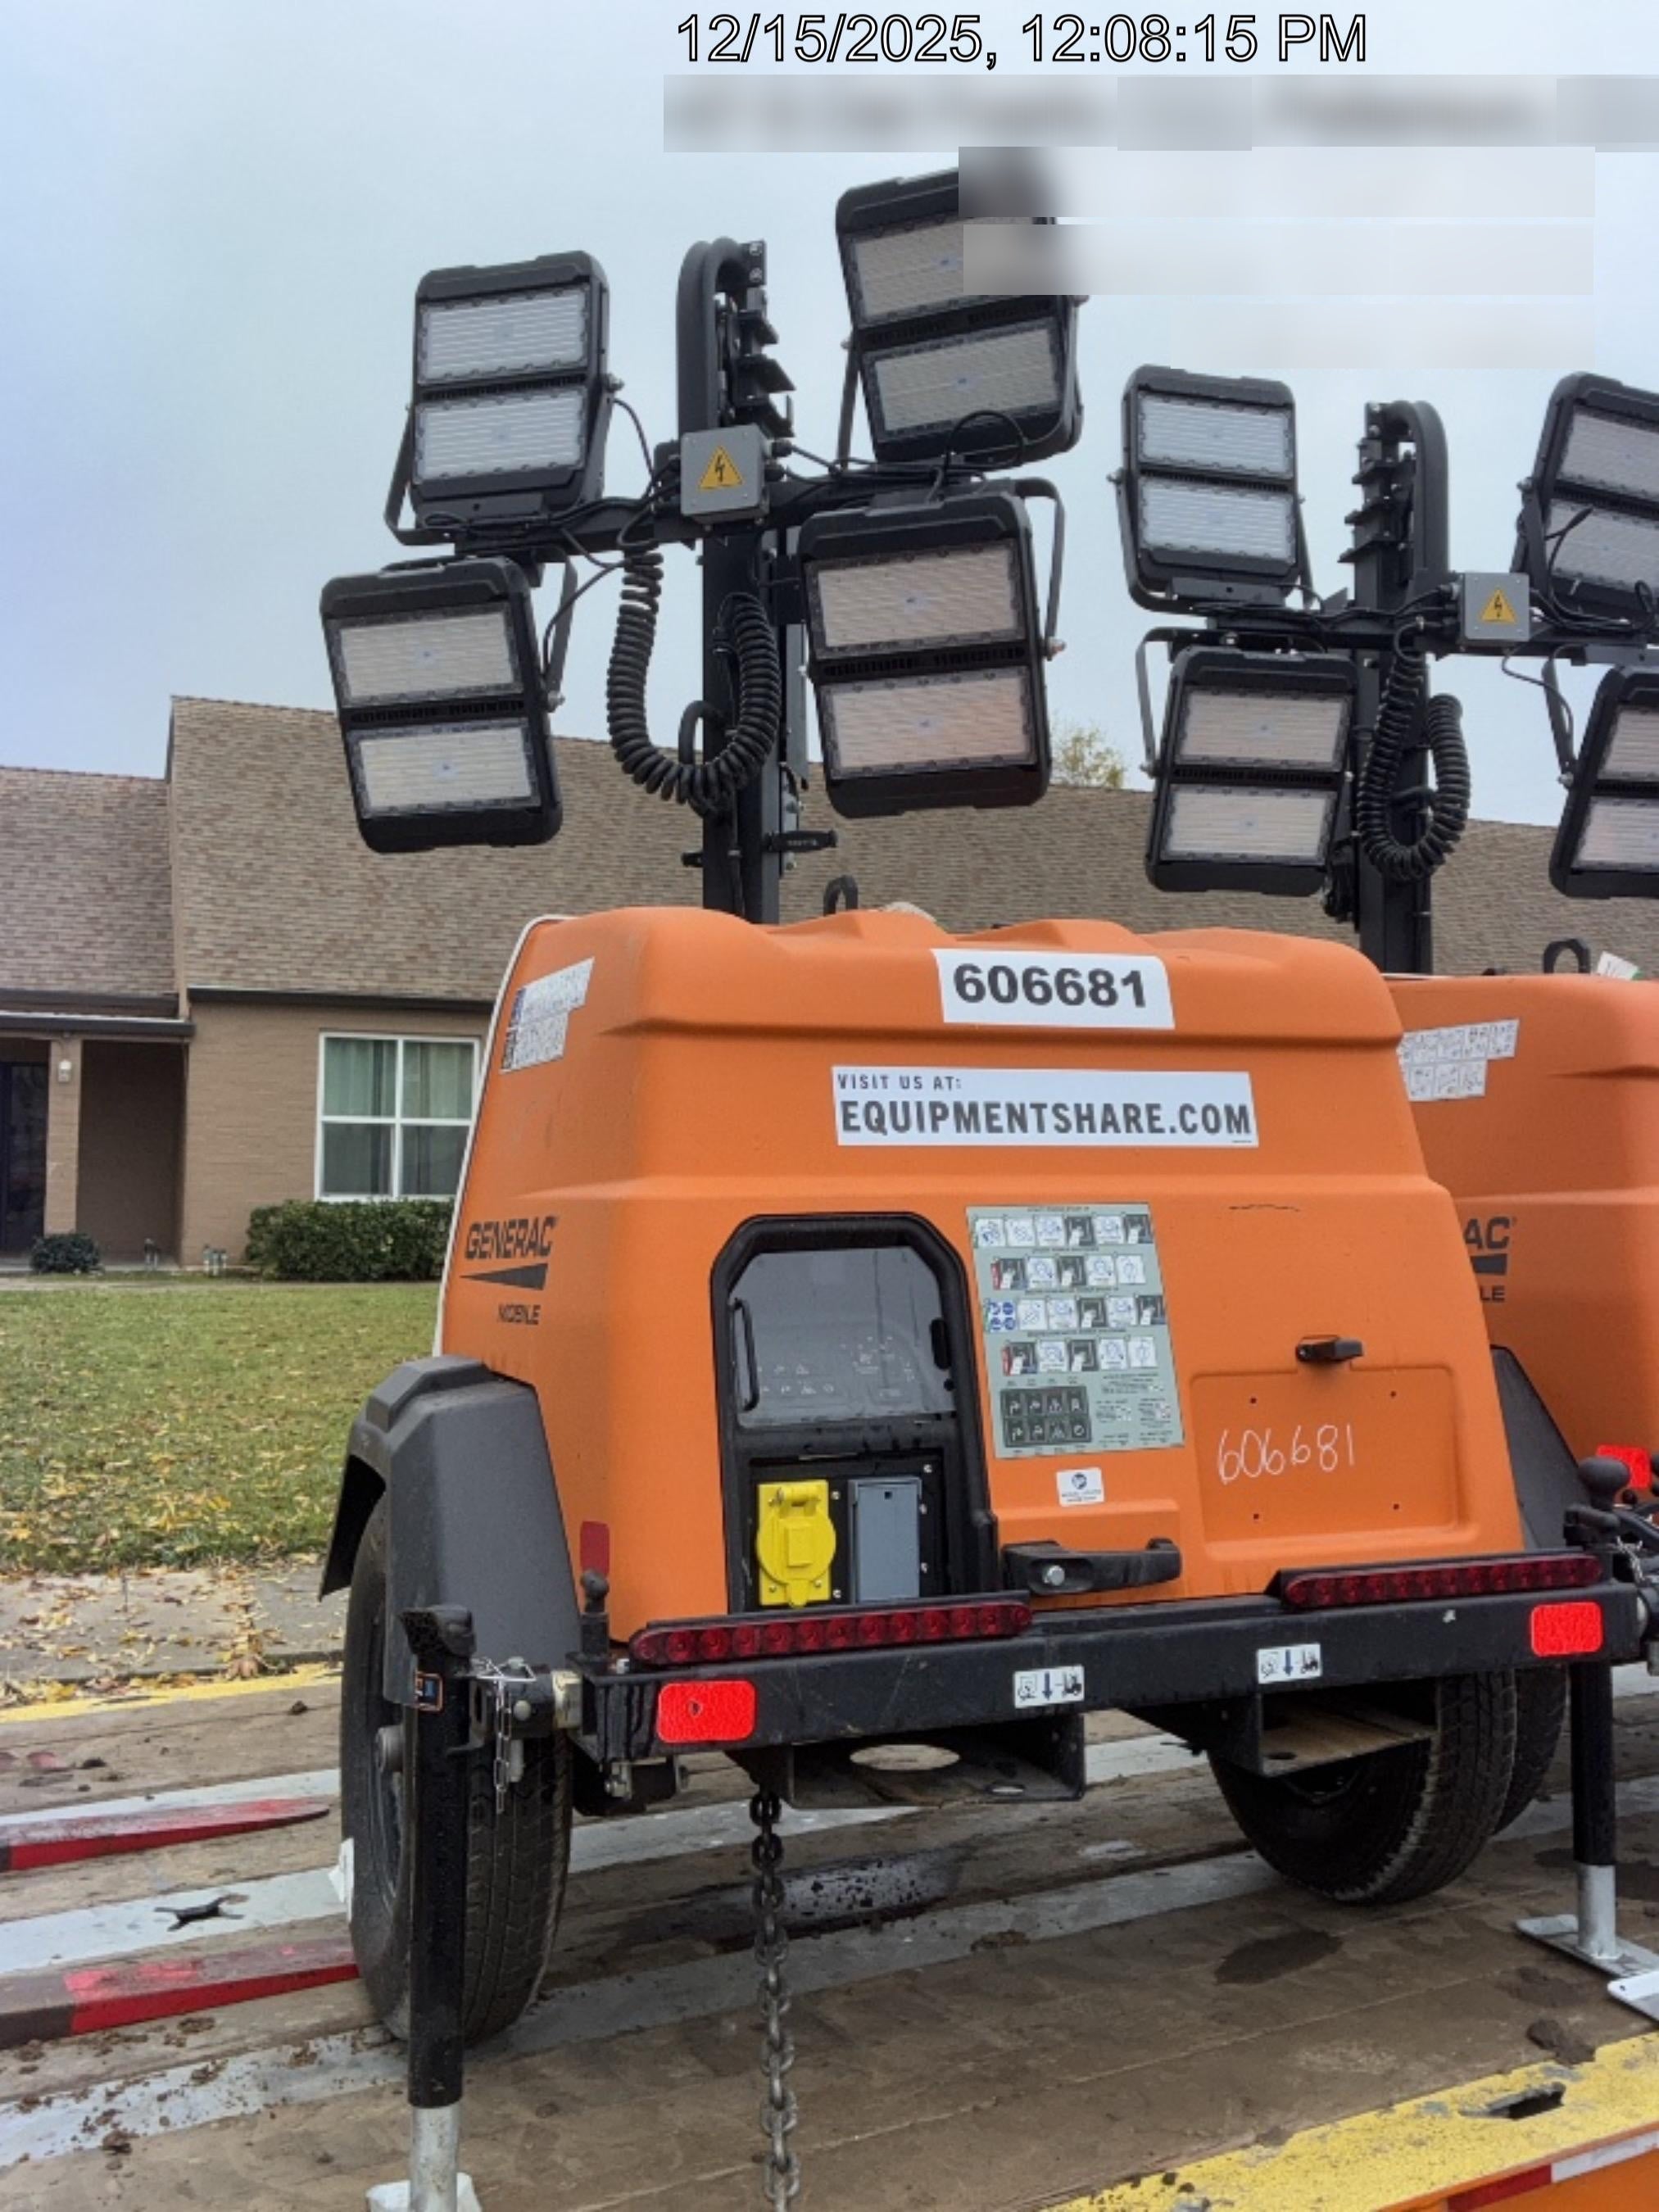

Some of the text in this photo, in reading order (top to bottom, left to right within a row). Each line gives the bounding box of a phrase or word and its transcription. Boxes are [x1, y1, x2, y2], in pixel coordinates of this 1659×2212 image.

[954, 963, 1146, 1009] 606681
[837, 1074, 963, 1091] VISIT US AT:
[841, 1100, 1251, 1136] EQUIPMENTSHARE.COM
[465, 1216, 557, 1260] GENERAC
[1217, 1423, 1355, 1485] 606681
